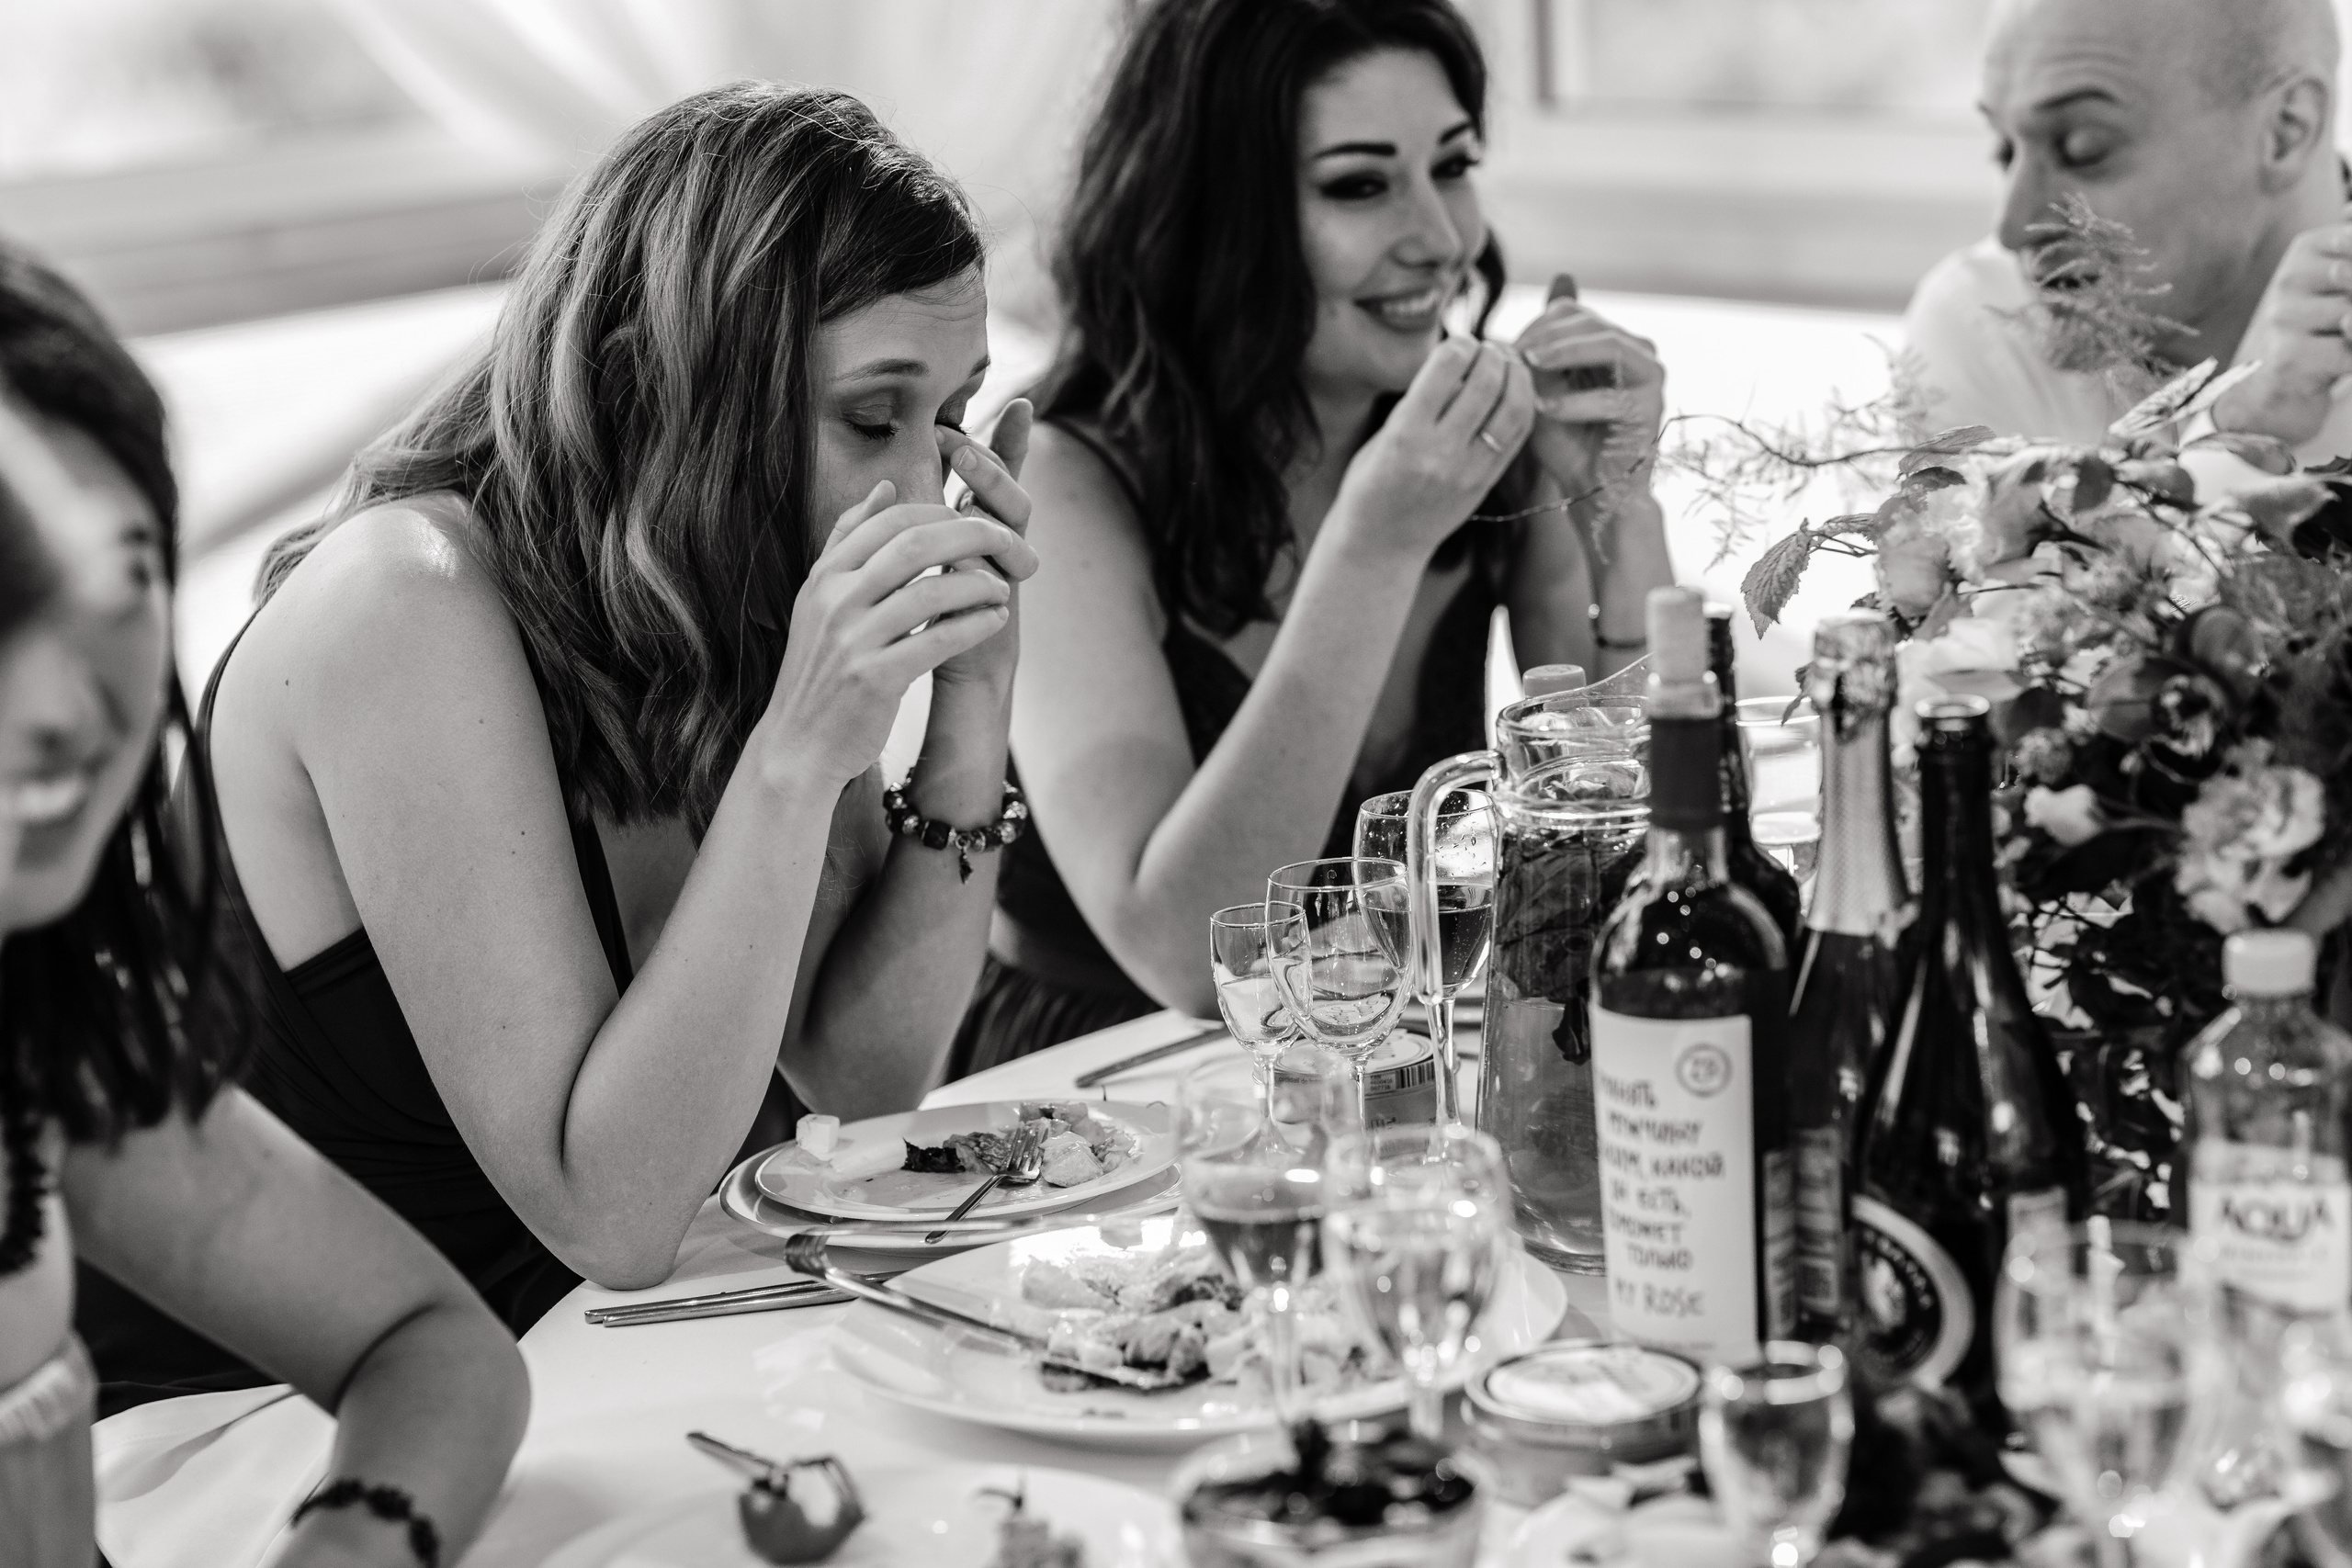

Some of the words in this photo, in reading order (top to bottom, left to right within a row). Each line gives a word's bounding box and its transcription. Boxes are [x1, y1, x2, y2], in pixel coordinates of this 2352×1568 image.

[1651, 1149, 1724, 1180] КАКОЙ
[2216, 1197, 2336, 1245] AQUA
[1626, 1242, 1693, 1271] ТОЛЬКО
